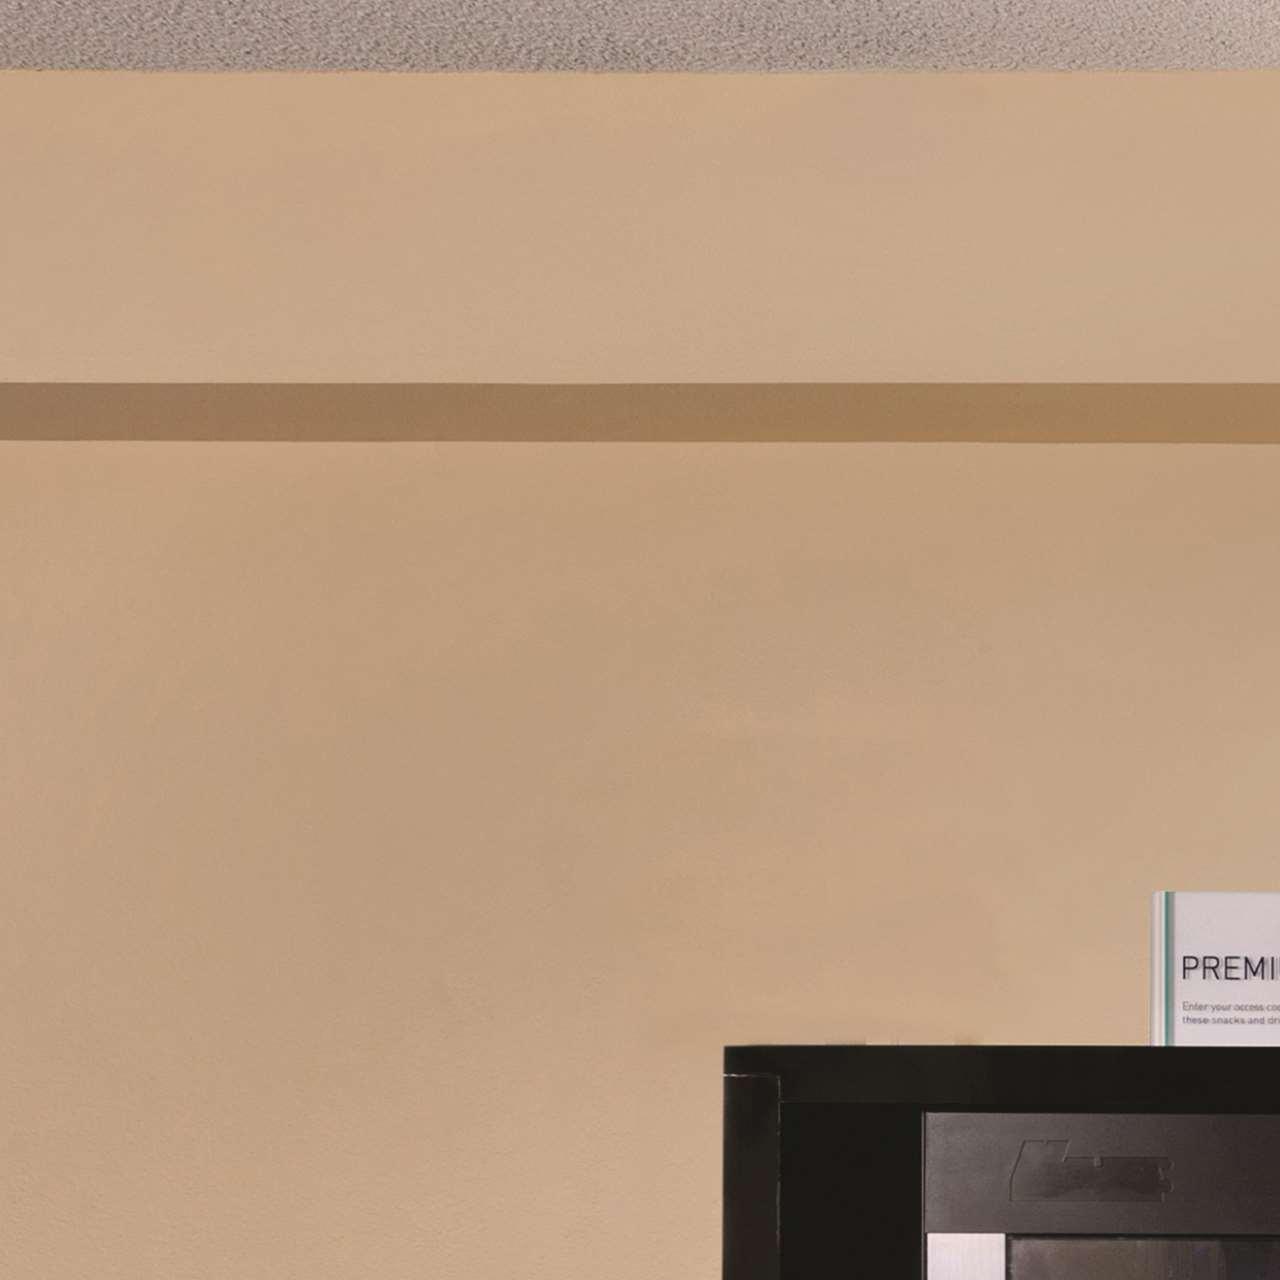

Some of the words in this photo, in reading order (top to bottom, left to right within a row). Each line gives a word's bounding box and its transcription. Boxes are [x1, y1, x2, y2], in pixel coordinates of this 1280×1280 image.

[1182, 1001, 1209, 1012] Enter
[1210, 1004, 1232, 1013] your
[1234, 1003, 1264, 1012] access
[1182, 1015, 1209, 1025] these
[1211, 1015, 1245, 1025] snacks
[1247, 1015, 1265, 1025] and
